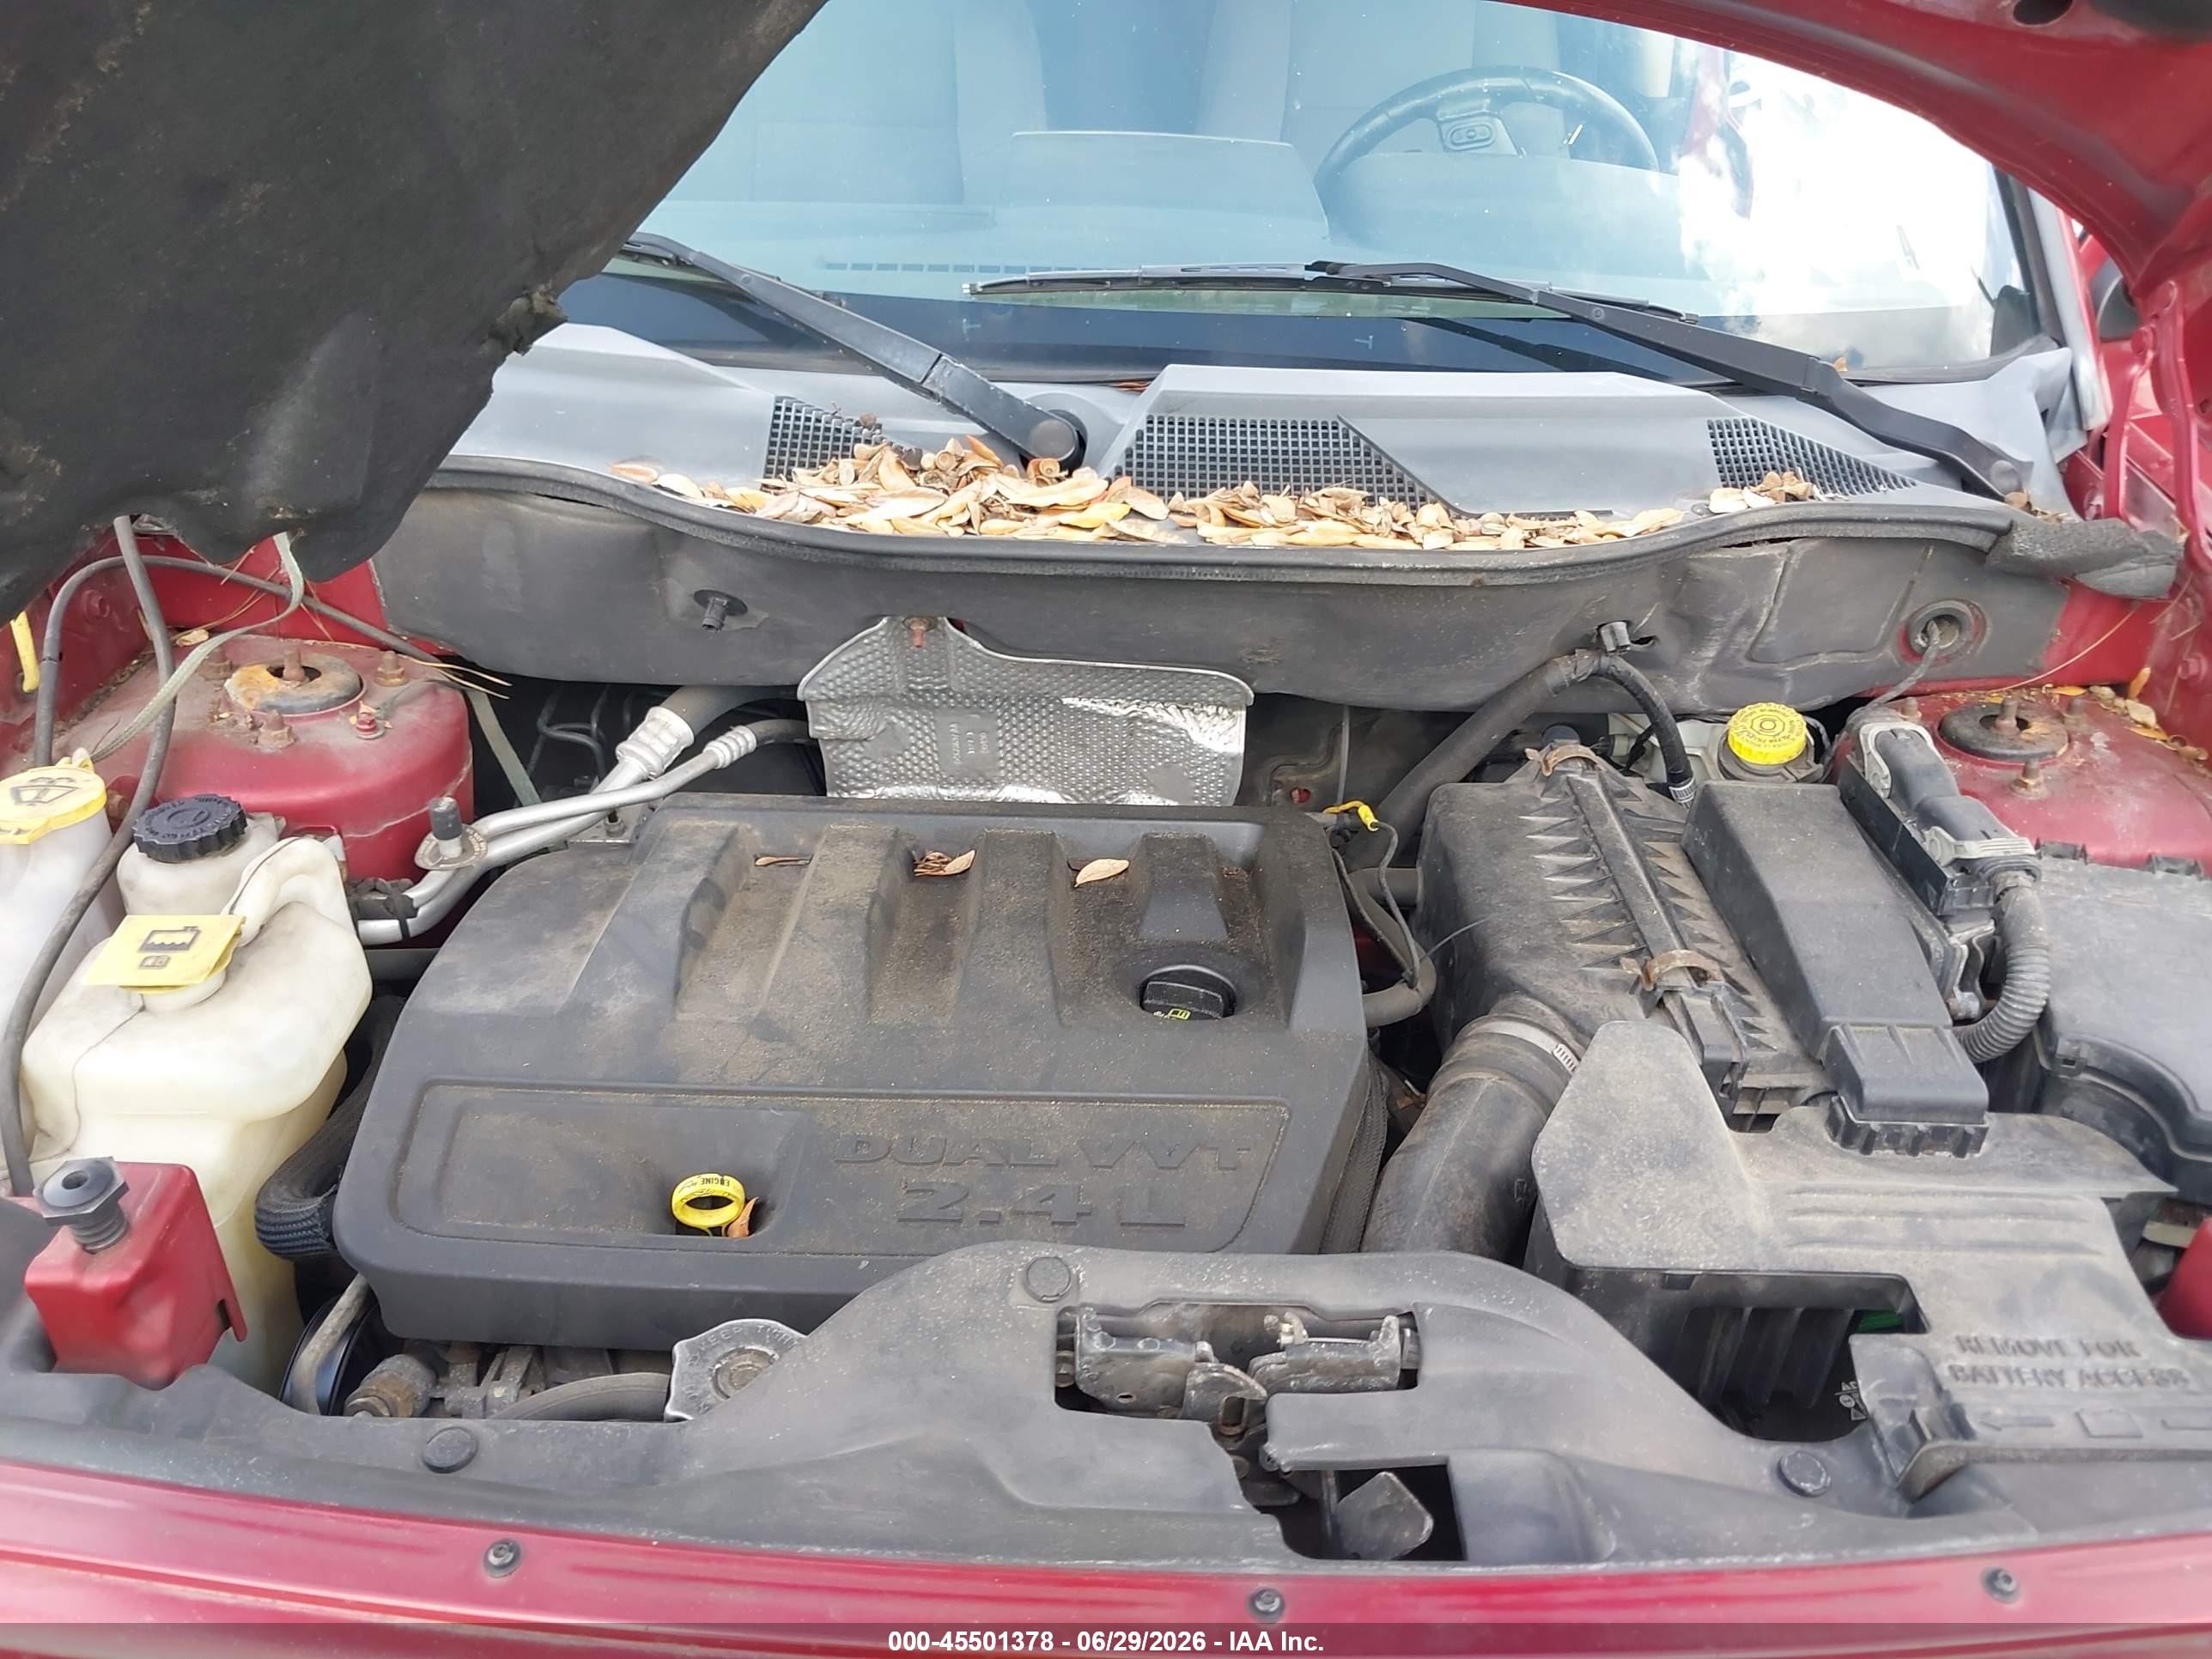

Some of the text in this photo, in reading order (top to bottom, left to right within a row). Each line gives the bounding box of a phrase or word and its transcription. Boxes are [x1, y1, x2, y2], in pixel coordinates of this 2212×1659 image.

[833, 1133, 1252, 1171] DUAL VVT
[1956, 1334, 2142, 1358] REMOVE FOR
[1948, 1364, 2191, 1388] BATTERY ACCESS
